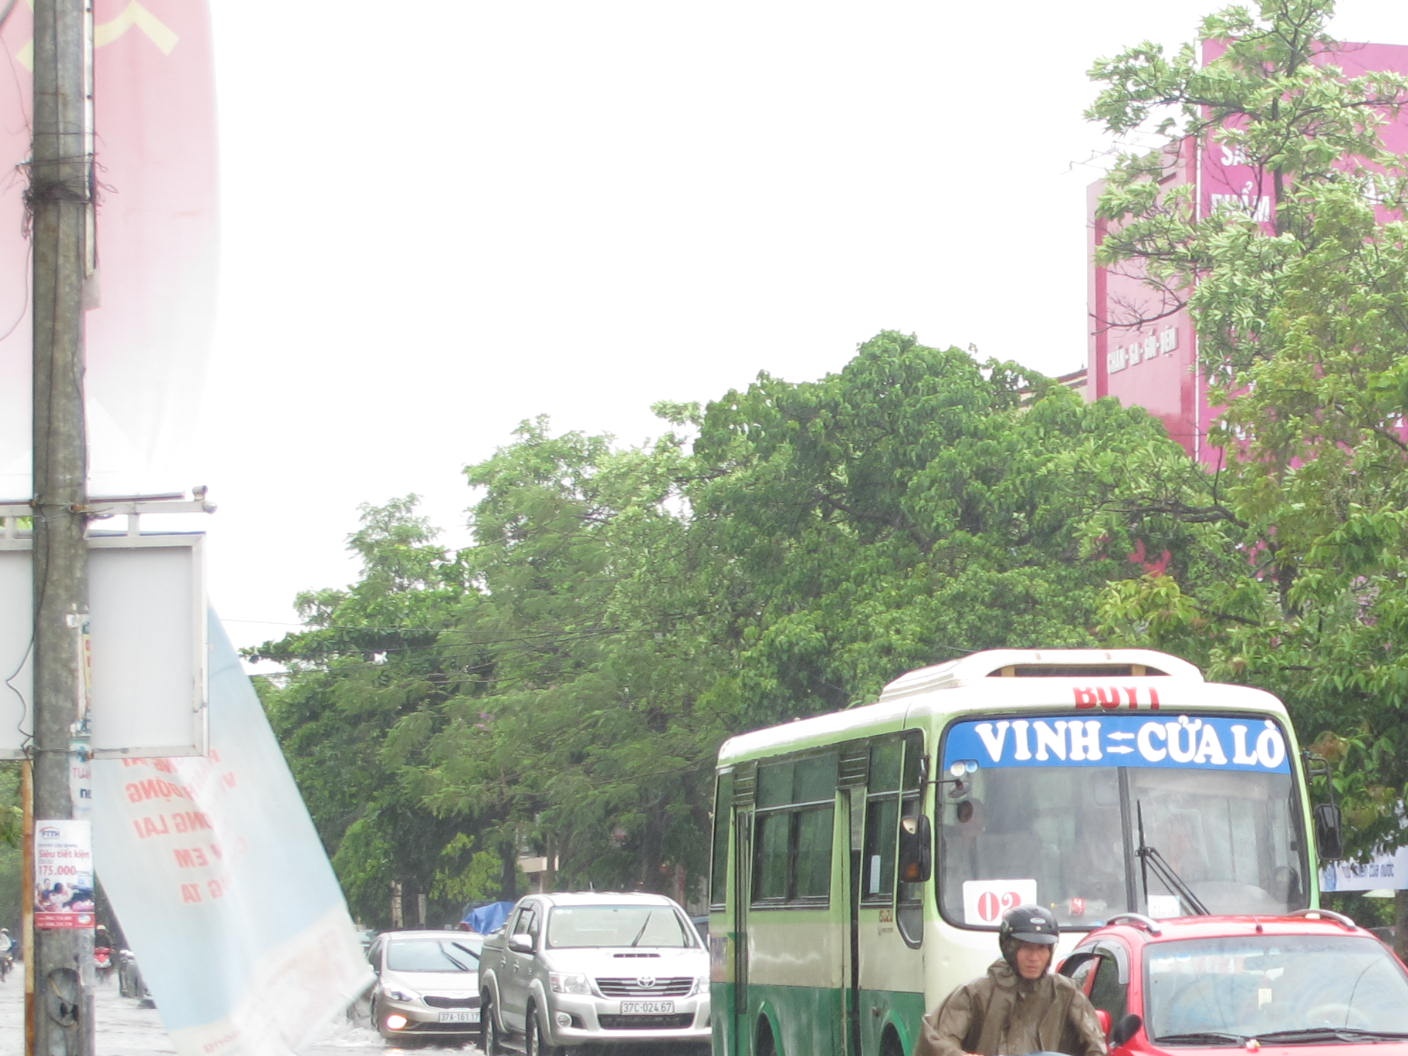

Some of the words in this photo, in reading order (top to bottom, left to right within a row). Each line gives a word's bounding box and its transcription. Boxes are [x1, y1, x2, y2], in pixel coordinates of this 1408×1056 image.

[974, 719, 1103, 763] VINH
[1137, 714, 1228, 766] CỬA
[1230, 719, 1286, 769] LÒ
